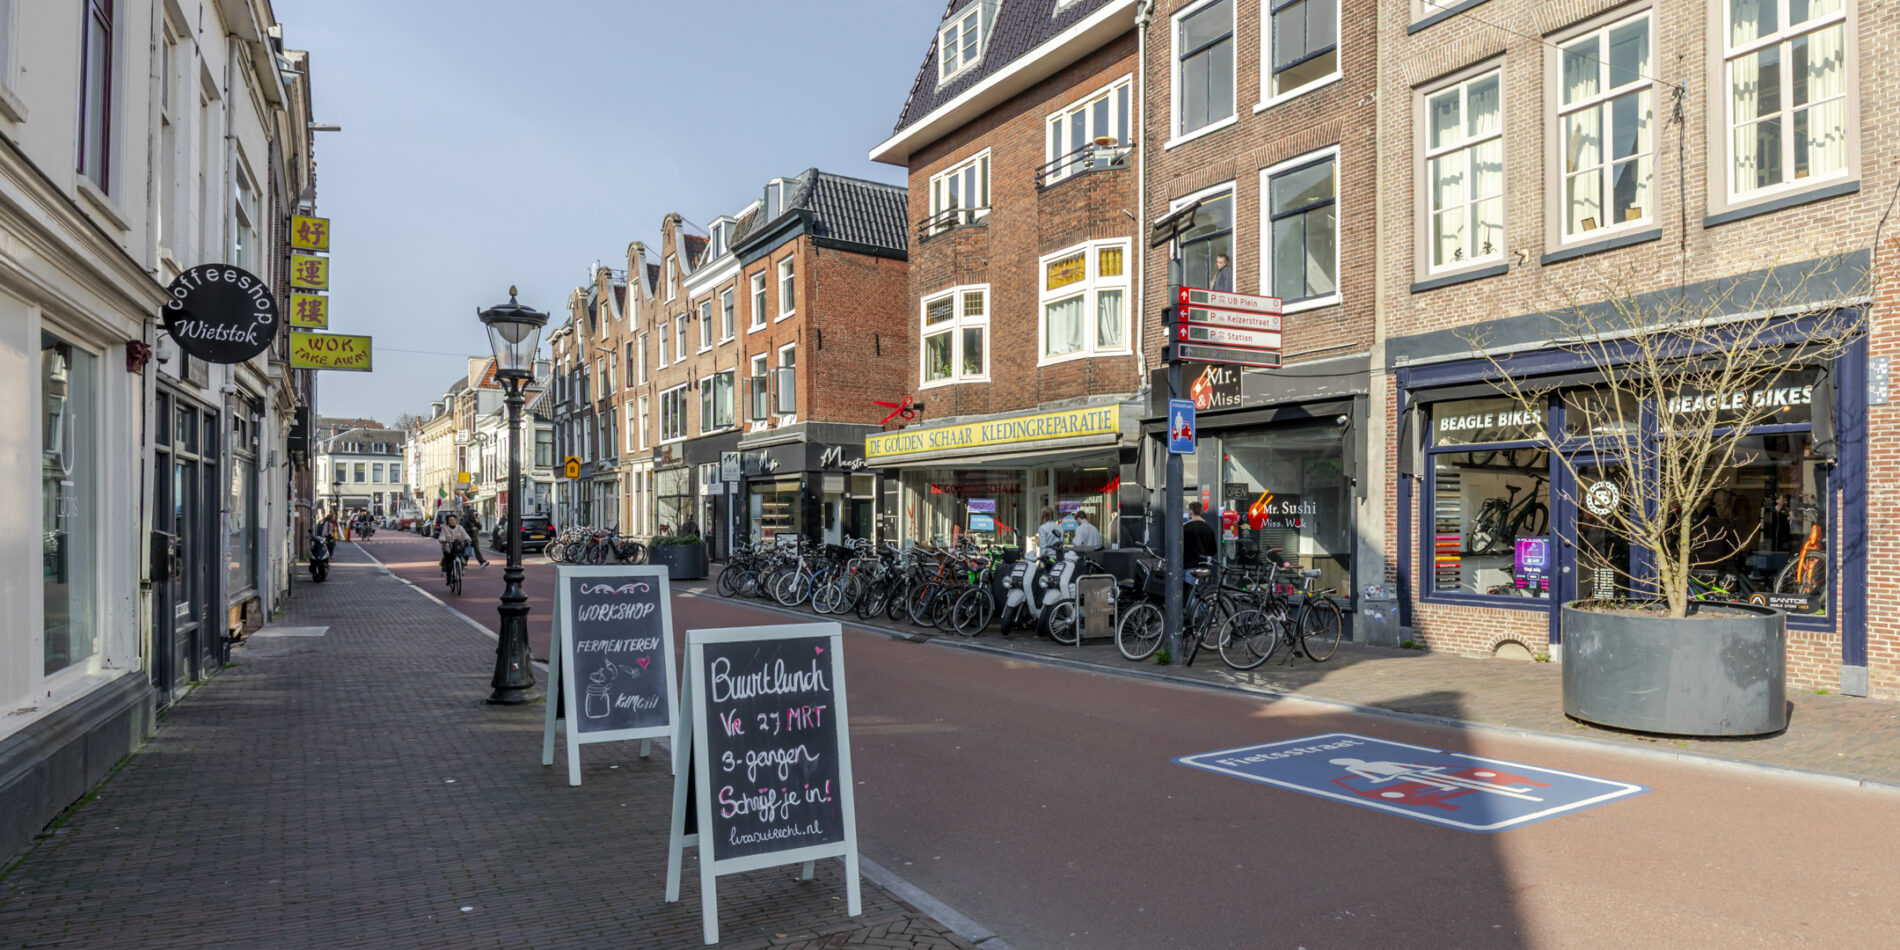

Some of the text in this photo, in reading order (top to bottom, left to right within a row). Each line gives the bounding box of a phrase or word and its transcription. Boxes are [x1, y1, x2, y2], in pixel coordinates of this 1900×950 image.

[1227, 297, 1238, 305] UB
[1240, 298, 1258, 308] Plein
[1227, 315, 1270, 326] Keizerstraat
[174, 319, 260, 346] Wietstok
[1227, 333, 1253, 342] Station
[308, 338, 355, 352] WOK
[294, 347, 368, 366] TAKE AWAY
[1206, 367, 1237, 386] Mr.
[1207, 392, 1241, 410] Miss
[1668, 386, 1814, 413] BEAGLE BIKES
[1440, 409, 1542, 431] BEAGLE BIKES
[870, 409, 1112, 455] DE GOUDEN SCHAAR KLEDINGREPARATIE
[1263, 501, 1316, 515] Mr. Sushi
[1769, 596, 1808, 605] SANTOS
[578, 602, 655, 622] WORKSHOP
[577, 637, 660, 655] FERMENTEREN
[711, 656, 830, 703] Buurtlunch
[757, 711, 780, 736] 27
[786, 705, 827, 731] MRT
[1215, 739, 1365, 767] Fietsstraat
[721, 744, 820, 784] 3-gangen
[718, 779, 833, 823] Schrijf je in!
